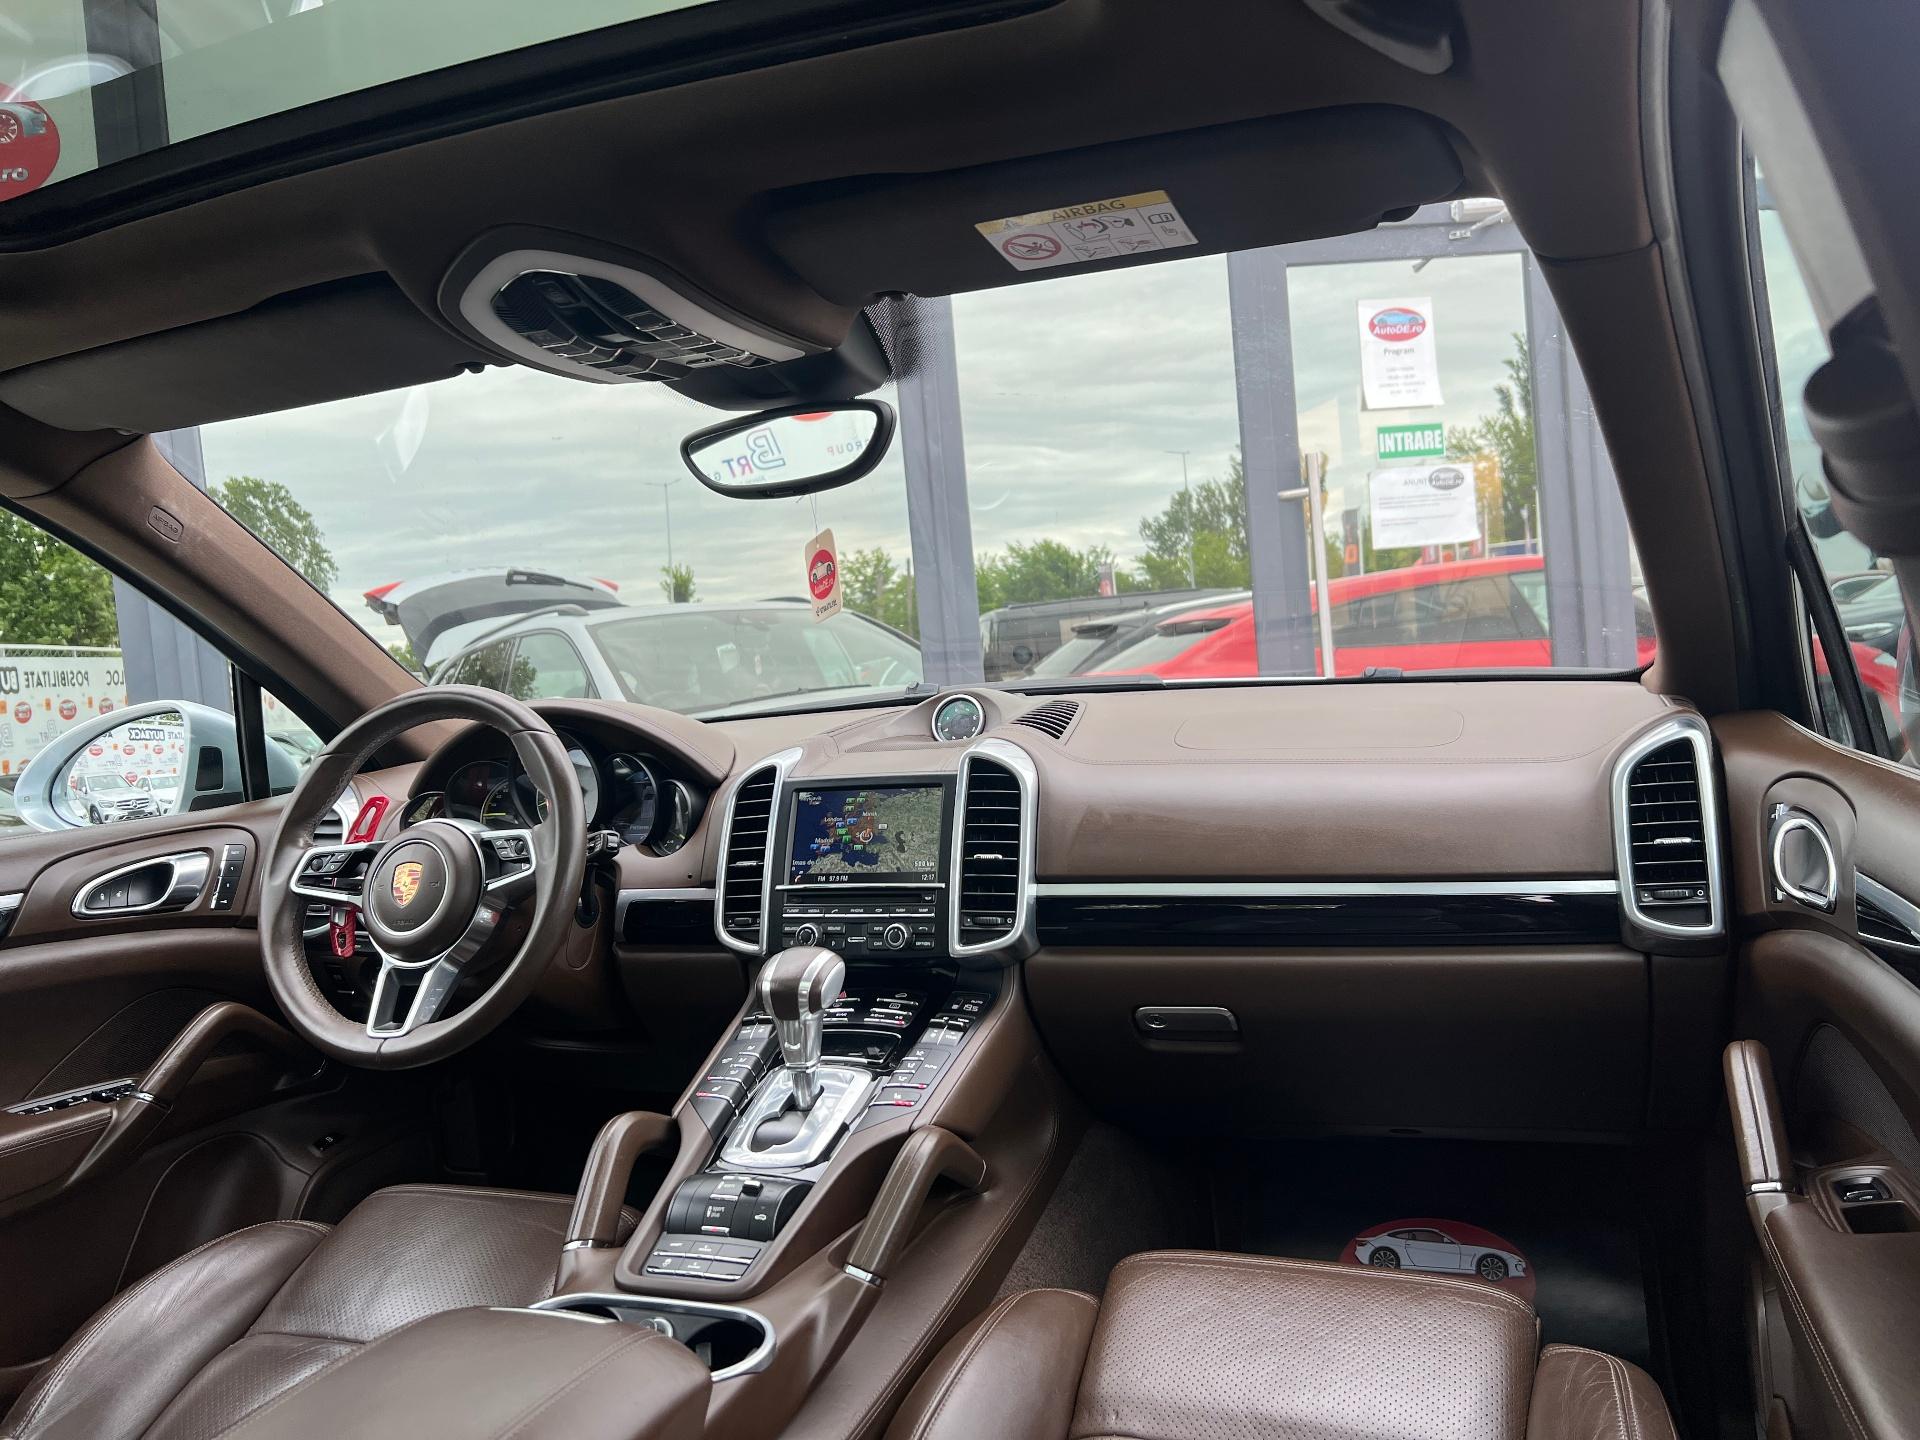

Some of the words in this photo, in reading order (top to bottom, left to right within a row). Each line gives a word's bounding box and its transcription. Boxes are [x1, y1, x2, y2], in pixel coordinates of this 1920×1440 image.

[1052, 199, 1126, 221] AIRBAG
[1373, 323, 1423, 336] AutoDE.ro
[1383, 346, 1415, 356] Program
[1378, 429, 1443, 453] INTRARE
